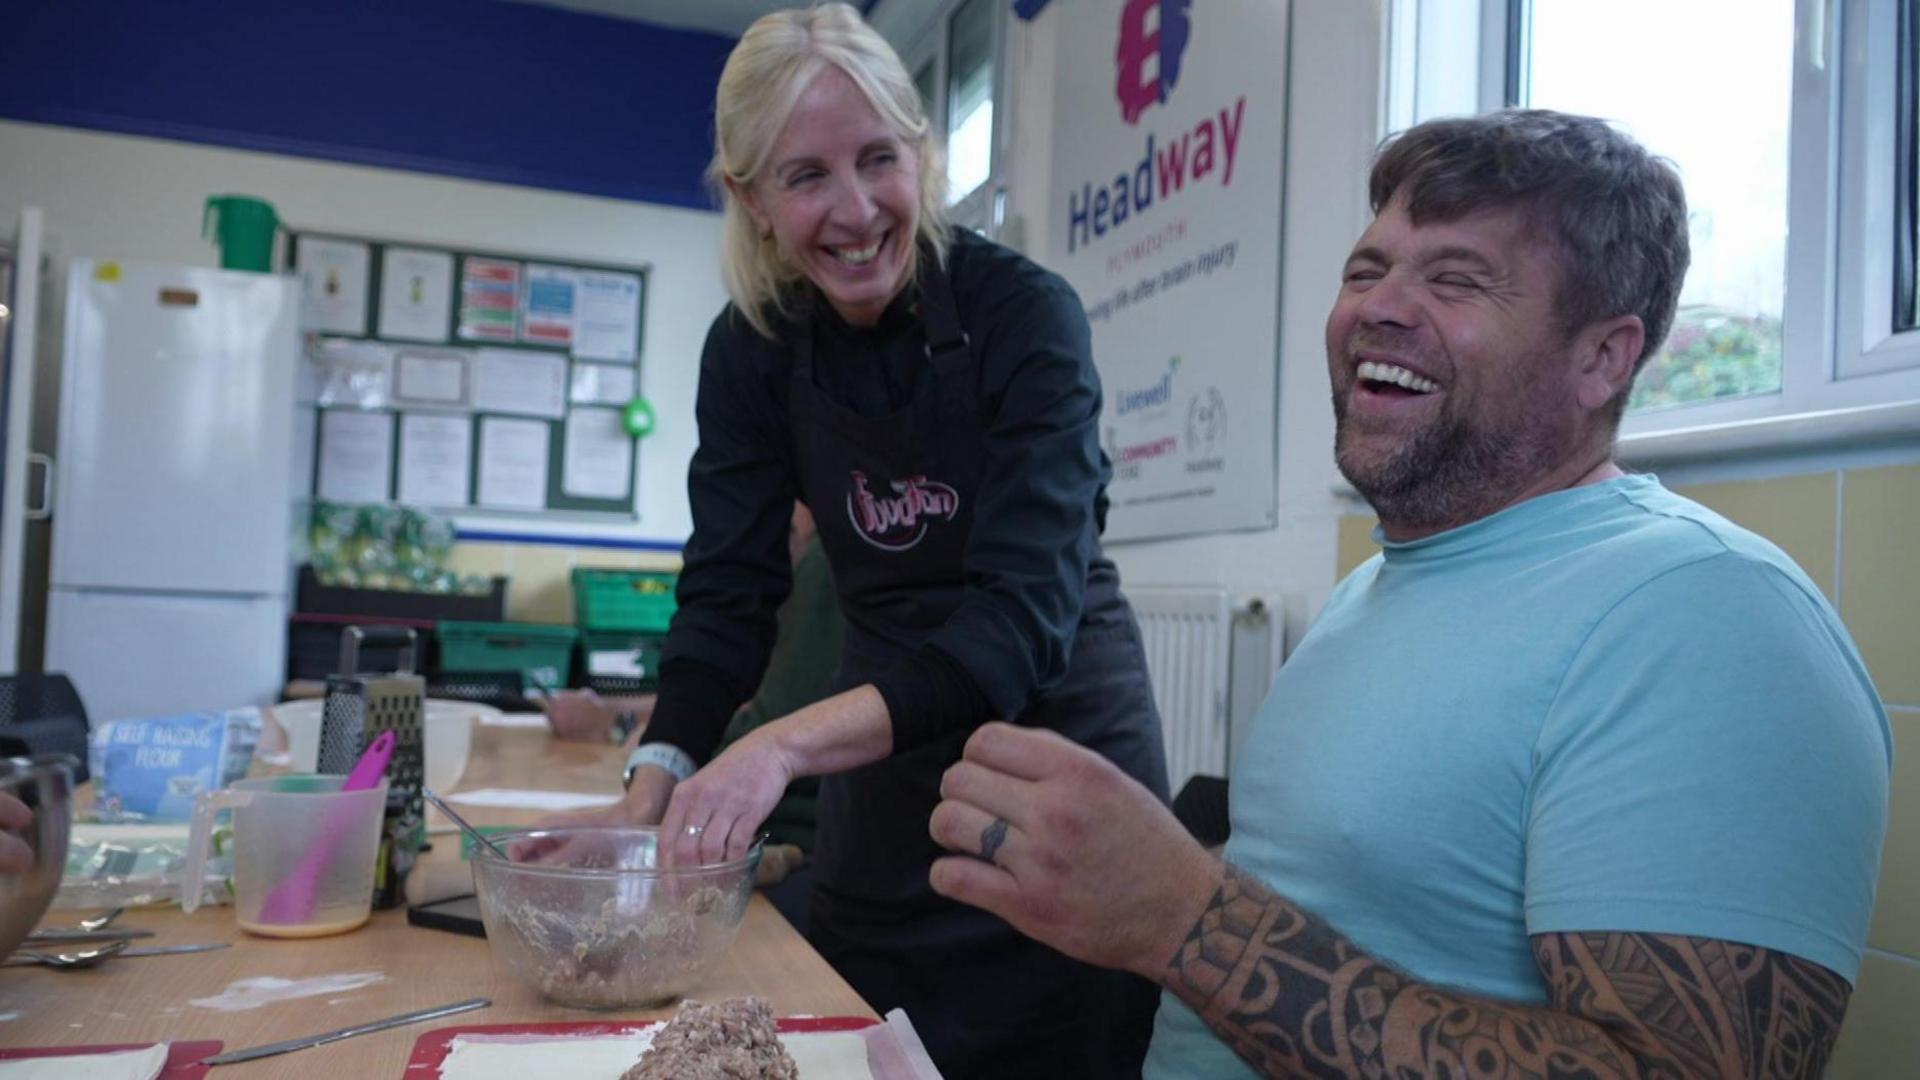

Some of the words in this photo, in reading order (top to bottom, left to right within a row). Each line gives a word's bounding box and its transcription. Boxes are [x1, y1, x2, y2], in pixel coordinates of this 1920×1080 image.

[1068, 95, 1247, 254] Headway
[1105, 217, 1189, 275] PLYMOUTH
[1160, 255, 1193, 290] brain
[1197, 239, 1239, 276] injury
[115, 722, 148, 743] SELF
[153, 727, 210, 748] RAISING
[136, 748, 181, 768] FLOUR
